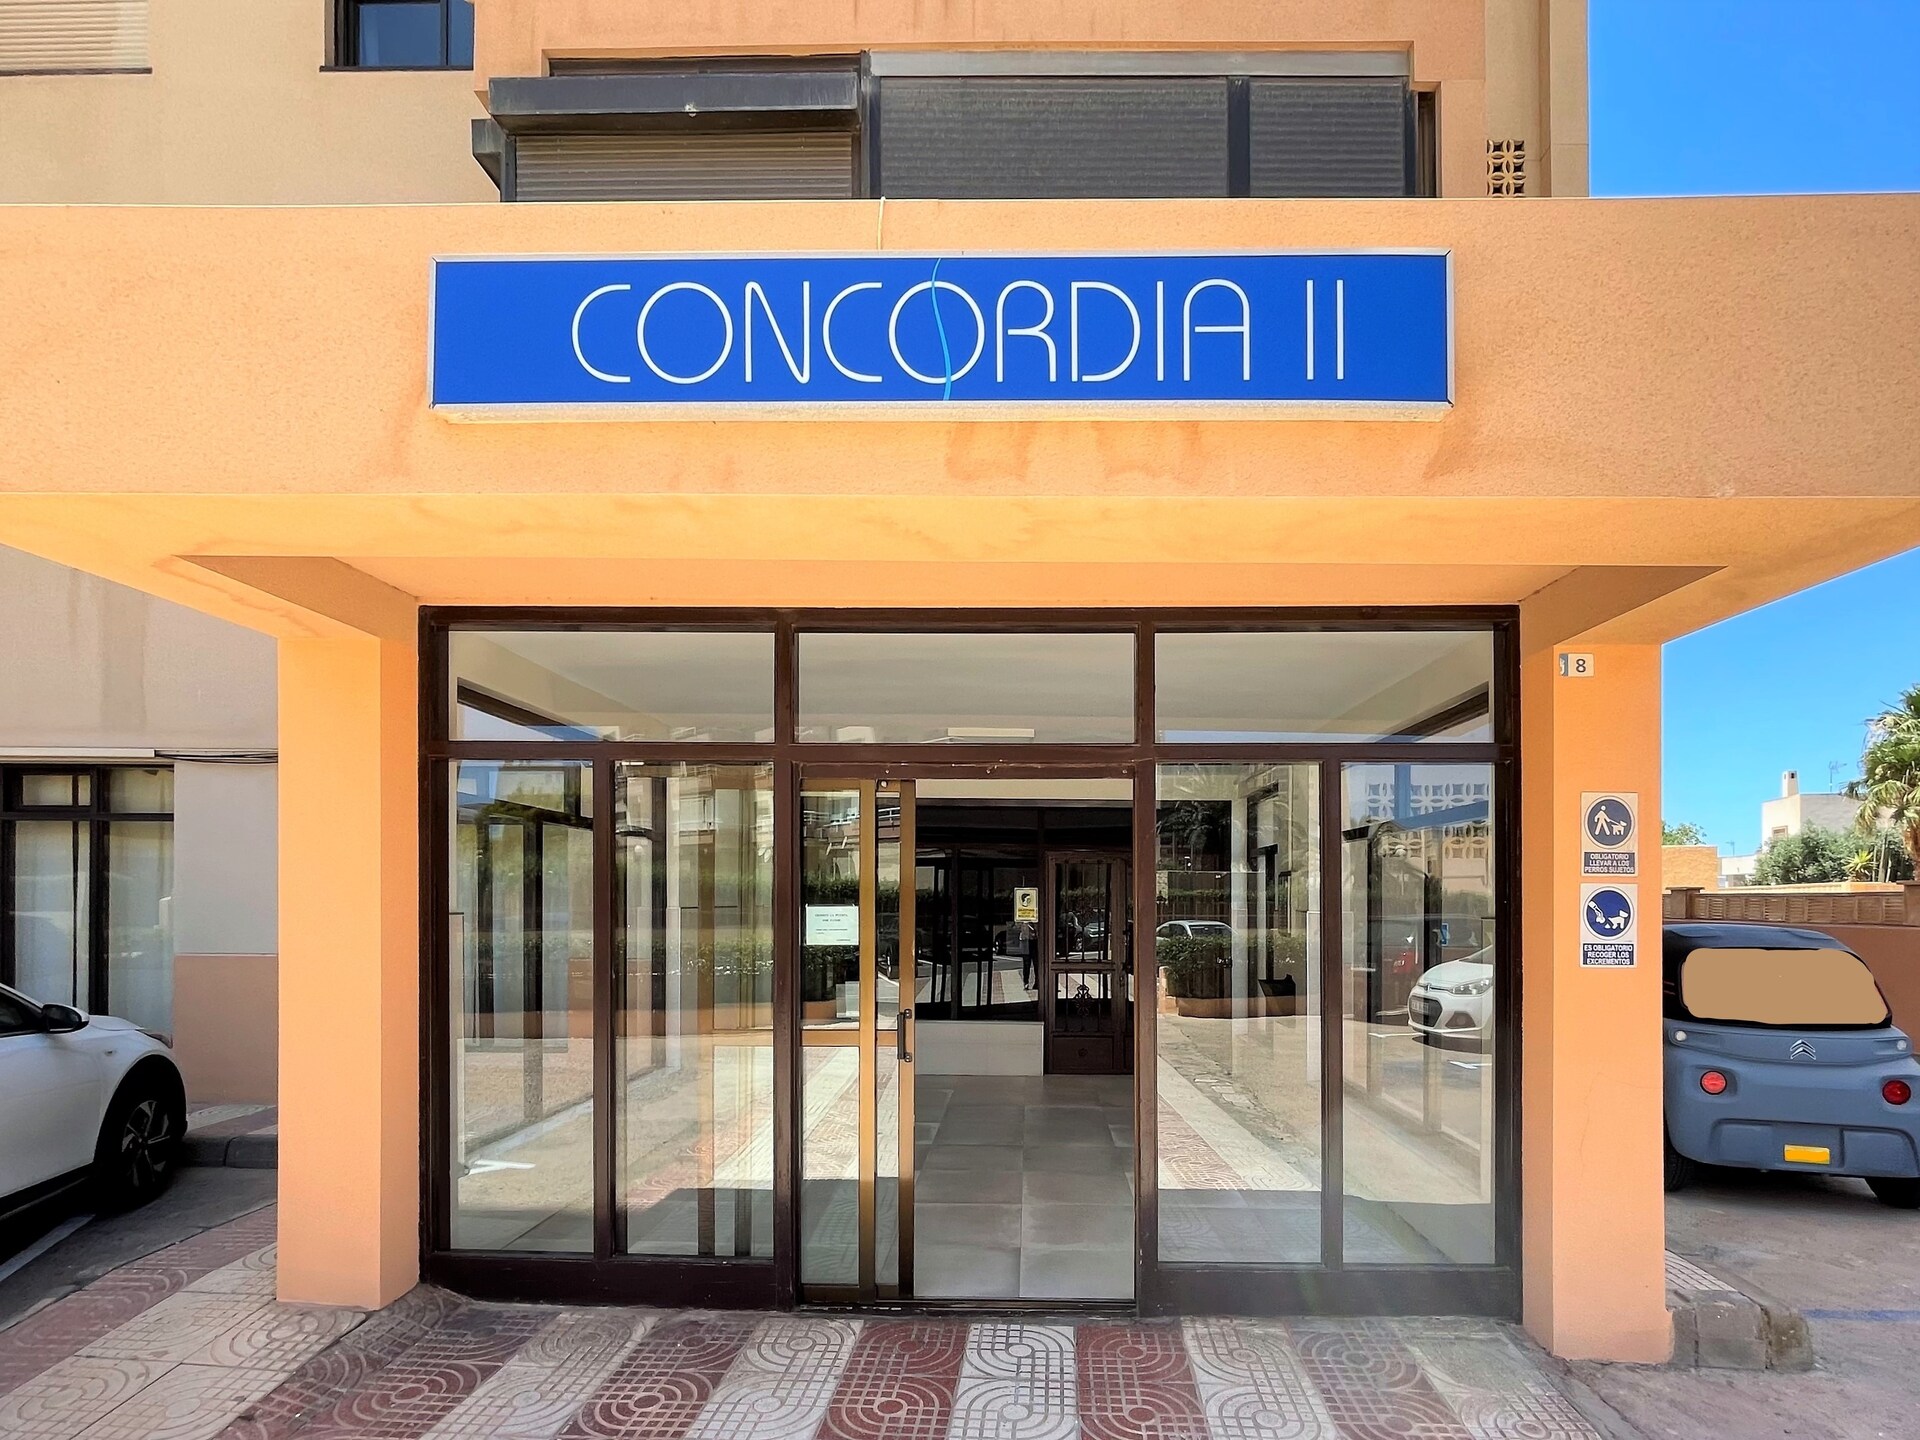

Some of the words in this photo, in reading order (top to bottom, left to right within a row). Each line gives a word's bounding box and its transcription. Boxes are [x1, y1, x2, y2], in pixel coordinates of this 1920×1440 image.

[571, 279, 1250, 384] CONCORDIA
[1306, 279, 1344, 381] II
[1575, 658, 1587, 673] 8
